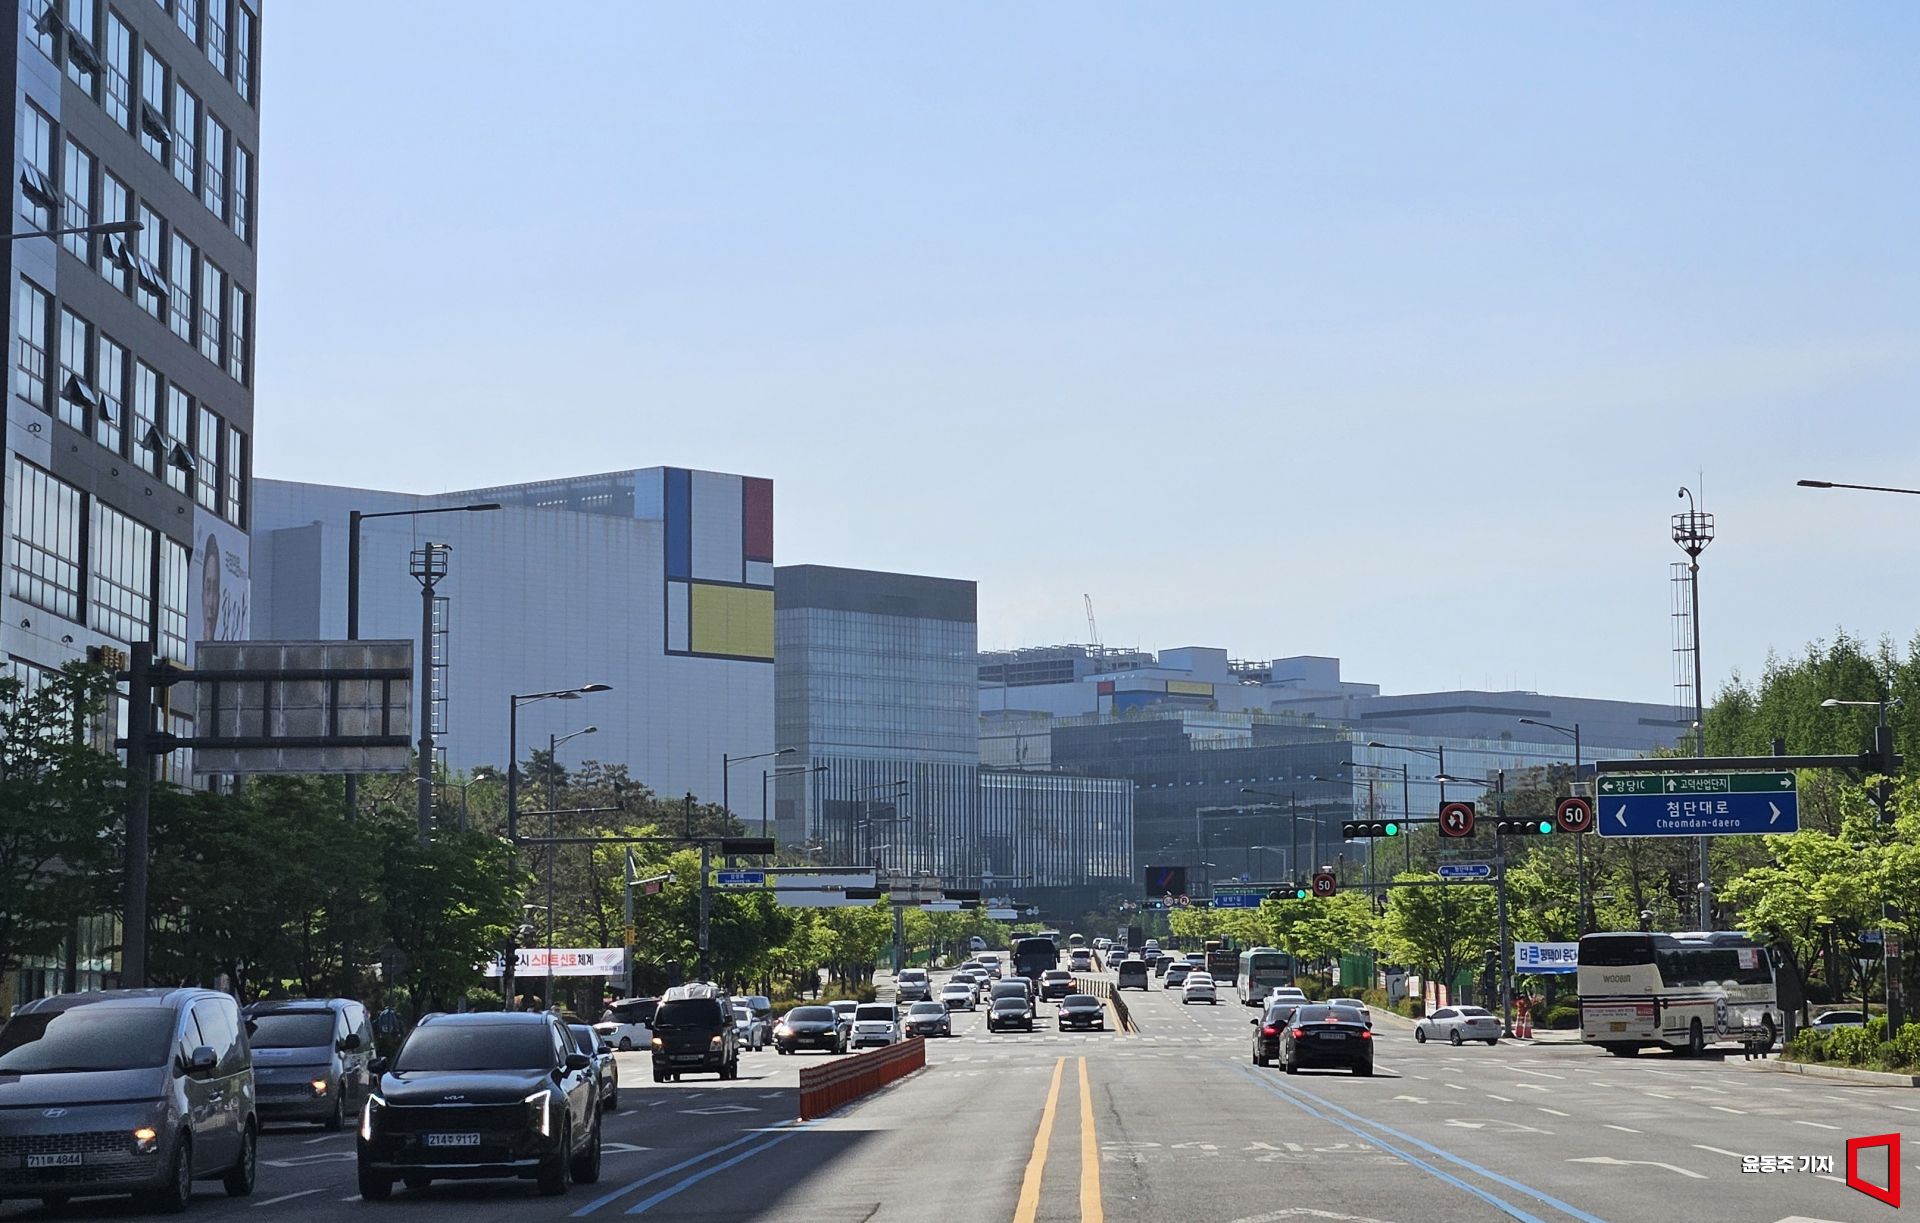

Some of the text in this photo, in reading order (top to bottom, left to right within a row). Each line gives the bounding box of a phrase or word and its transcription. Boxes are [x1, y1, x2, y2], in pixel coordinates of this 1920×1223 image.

[1615, 780, 1645, 793] 장당IC
[1680, 778, 1727, 791] 고덕산업단지
[1565, 807, 1583, 823] 50
[1666, 801, 1729, 818] 첨단대로
[1656, 818, 1741, 828] Cheomdan-daero
[1318, 880, 1330, 891] 50
[531, 953, 559, 967] 스마트
[1520, 948, 1527, 961] 더
[1529, 946, 1539, 964] 큰
[1540, 948, 1562, 962] 평택이
[455, 1134, 479, 1144] 9112
[56, 1154, 80, 1165] 4844
